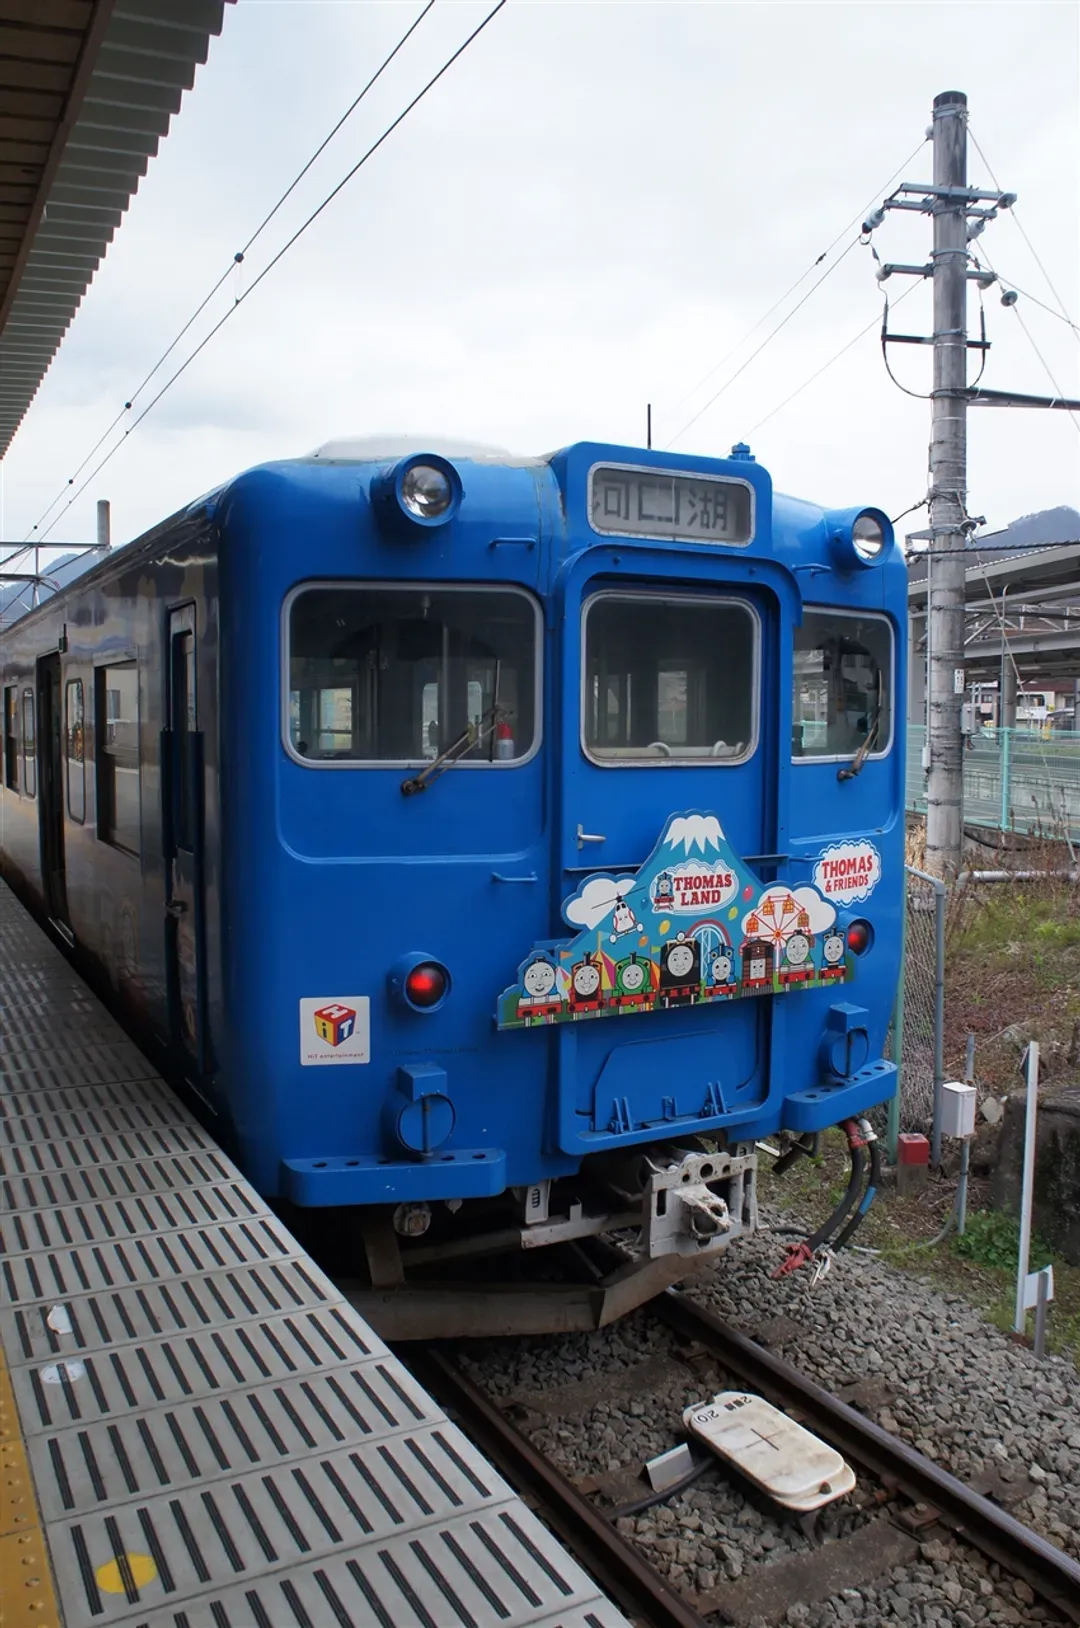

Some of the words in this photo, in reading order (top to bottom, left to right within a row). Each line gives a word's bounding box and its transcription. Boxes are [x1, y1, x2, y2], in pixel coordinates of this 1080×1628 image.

[821, 855, 873, 879] THOMAS
[674, 873, 732, 891] THOMAS
[825, 880, 832, 893] &
[834, 874, 869, 891] FRIENDS
[681, 889, 721, 906] LAND
